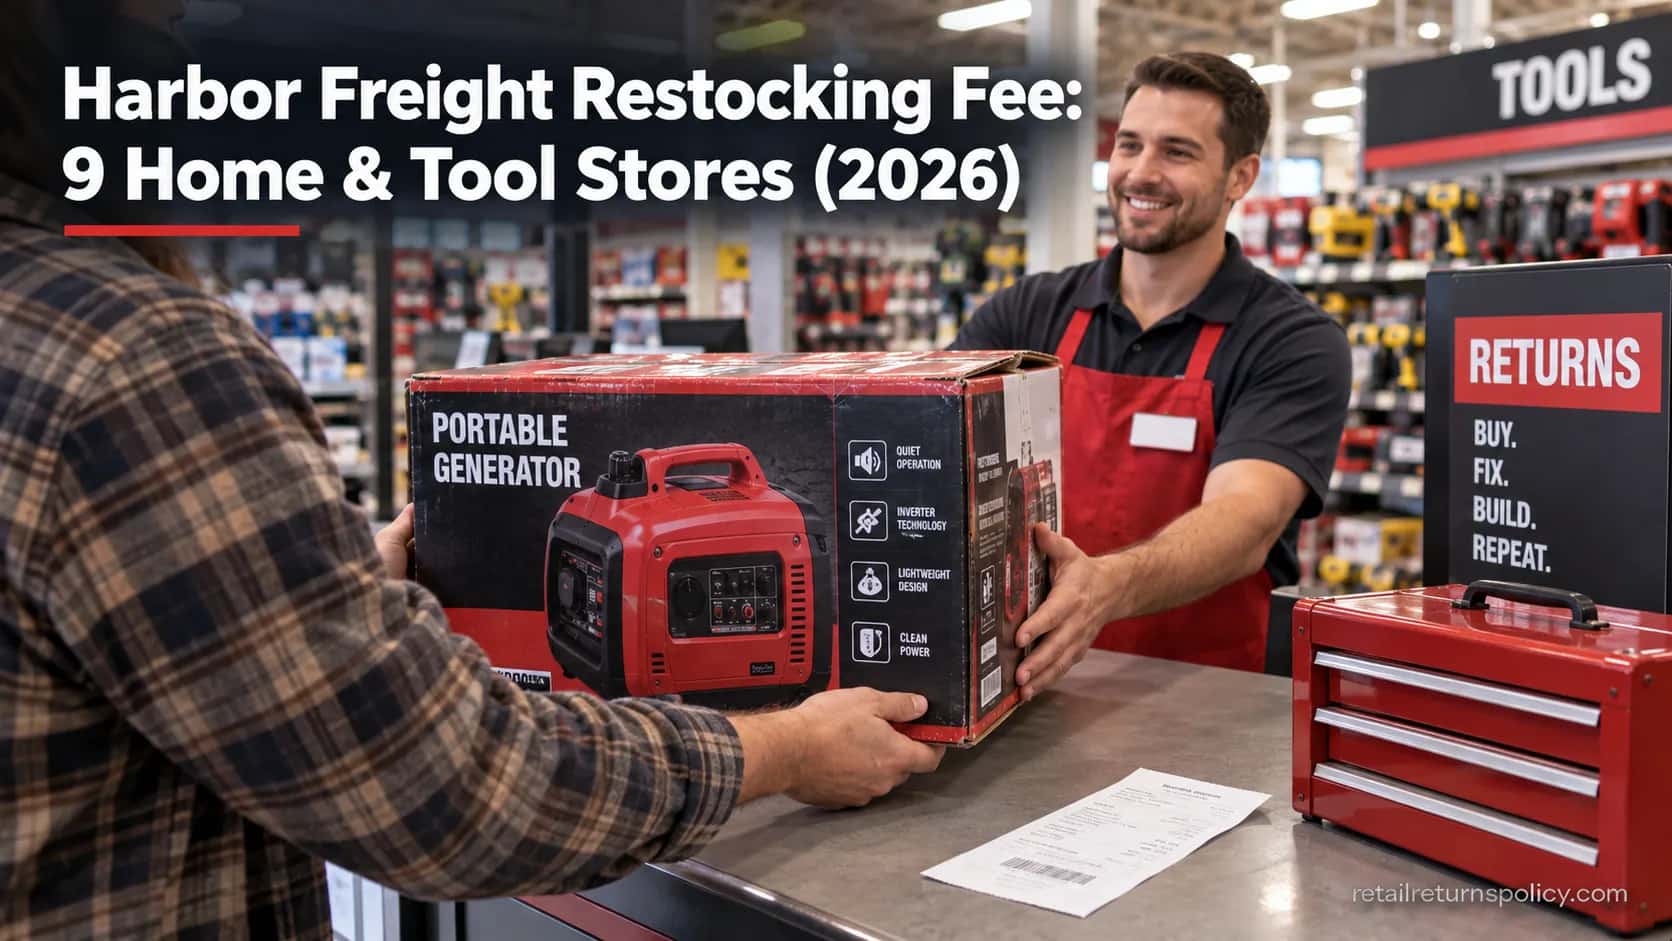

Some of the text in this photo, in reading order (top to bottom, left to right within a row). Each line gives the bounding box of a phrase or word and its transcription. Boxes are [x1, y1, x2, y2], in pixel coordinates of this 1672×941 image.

[1492, 37, 1652, 120] TOOLS
[1470, 337, 1641, 389] RETURNS
[432, 412, 569, 447] PORTABLE
[1473, 419, 1517, 449] BUY.
[896, 445, 921, 457] QUIET
[433, 452, 581, 489] GENERATOR
[896, 458, 942, 471] OPERATION
[1473, 457, 1509, 487] FIX.
[896, 506, 936, 518] INVERTER
[1473, 495, 1537, 530] BUILD.
[896, 519, 948, 532] TECHNOLOGY
[1472, 533, 1552, 573] REPEAT.
[898, 567, 952, 580] LIGHTWEIGHT
[898, 581, 928, 593] DESIGN
[899, 632, 928, 644] CLEAN
[900, 645, 931, 658] POWER
